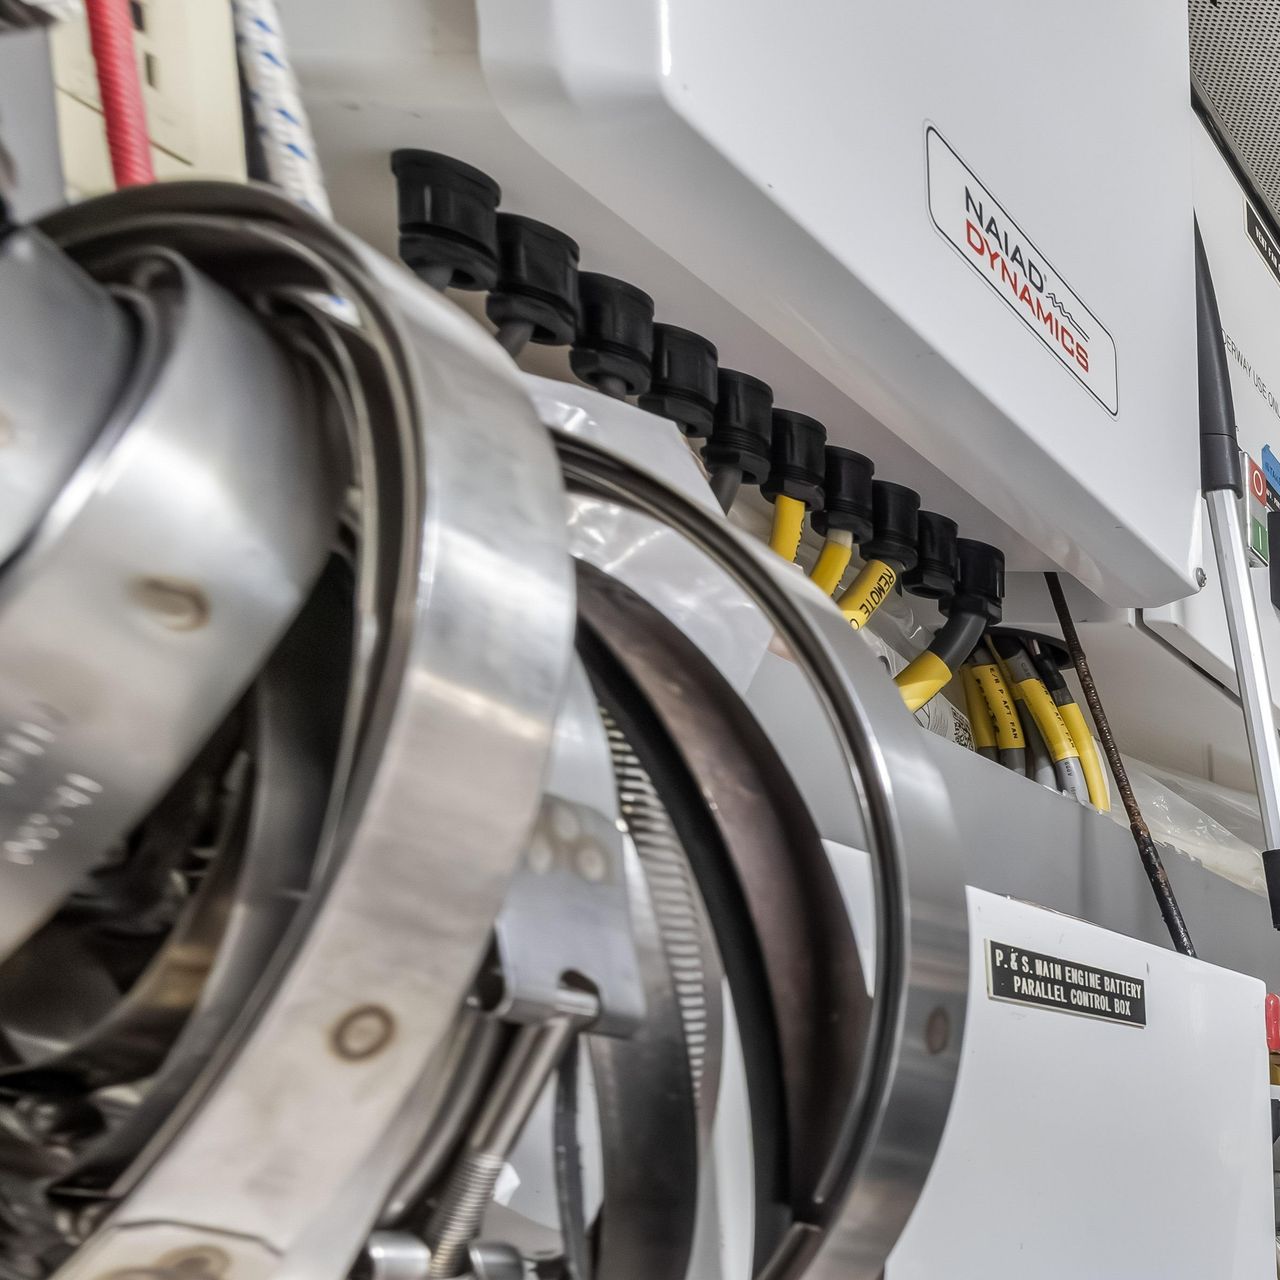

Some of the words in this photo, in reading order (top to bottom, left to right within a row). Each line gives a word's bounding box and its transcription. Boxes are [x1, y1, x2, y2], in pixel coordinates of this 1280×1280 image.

[964, 185, 1044, 293] NAIAD
[965, 218, 1090, 373] DYNAMICS
[1253, 370, 1268, 400] USE
[859, 567, 895, 620] REMOTE
[1002, 700, 1012, 718] AFT
[1009, 721, 1018, 739] FAN
[995, 949, 1008, 968] P.
[1010, 949, 1019, 970] &
[1021, 955, 1033, 974] S.
[1035, 959, 1062, 981] MAIN
[1065, 966, 1101, 990] ENGINE
[1104, 976, 1142, 999] BATTERY
[1013, 976, 1067, 1003] PARALLEL
[1070, 988, 1112, 1012] CONTROL
[1114, 999, 1131, 1016] BOX
